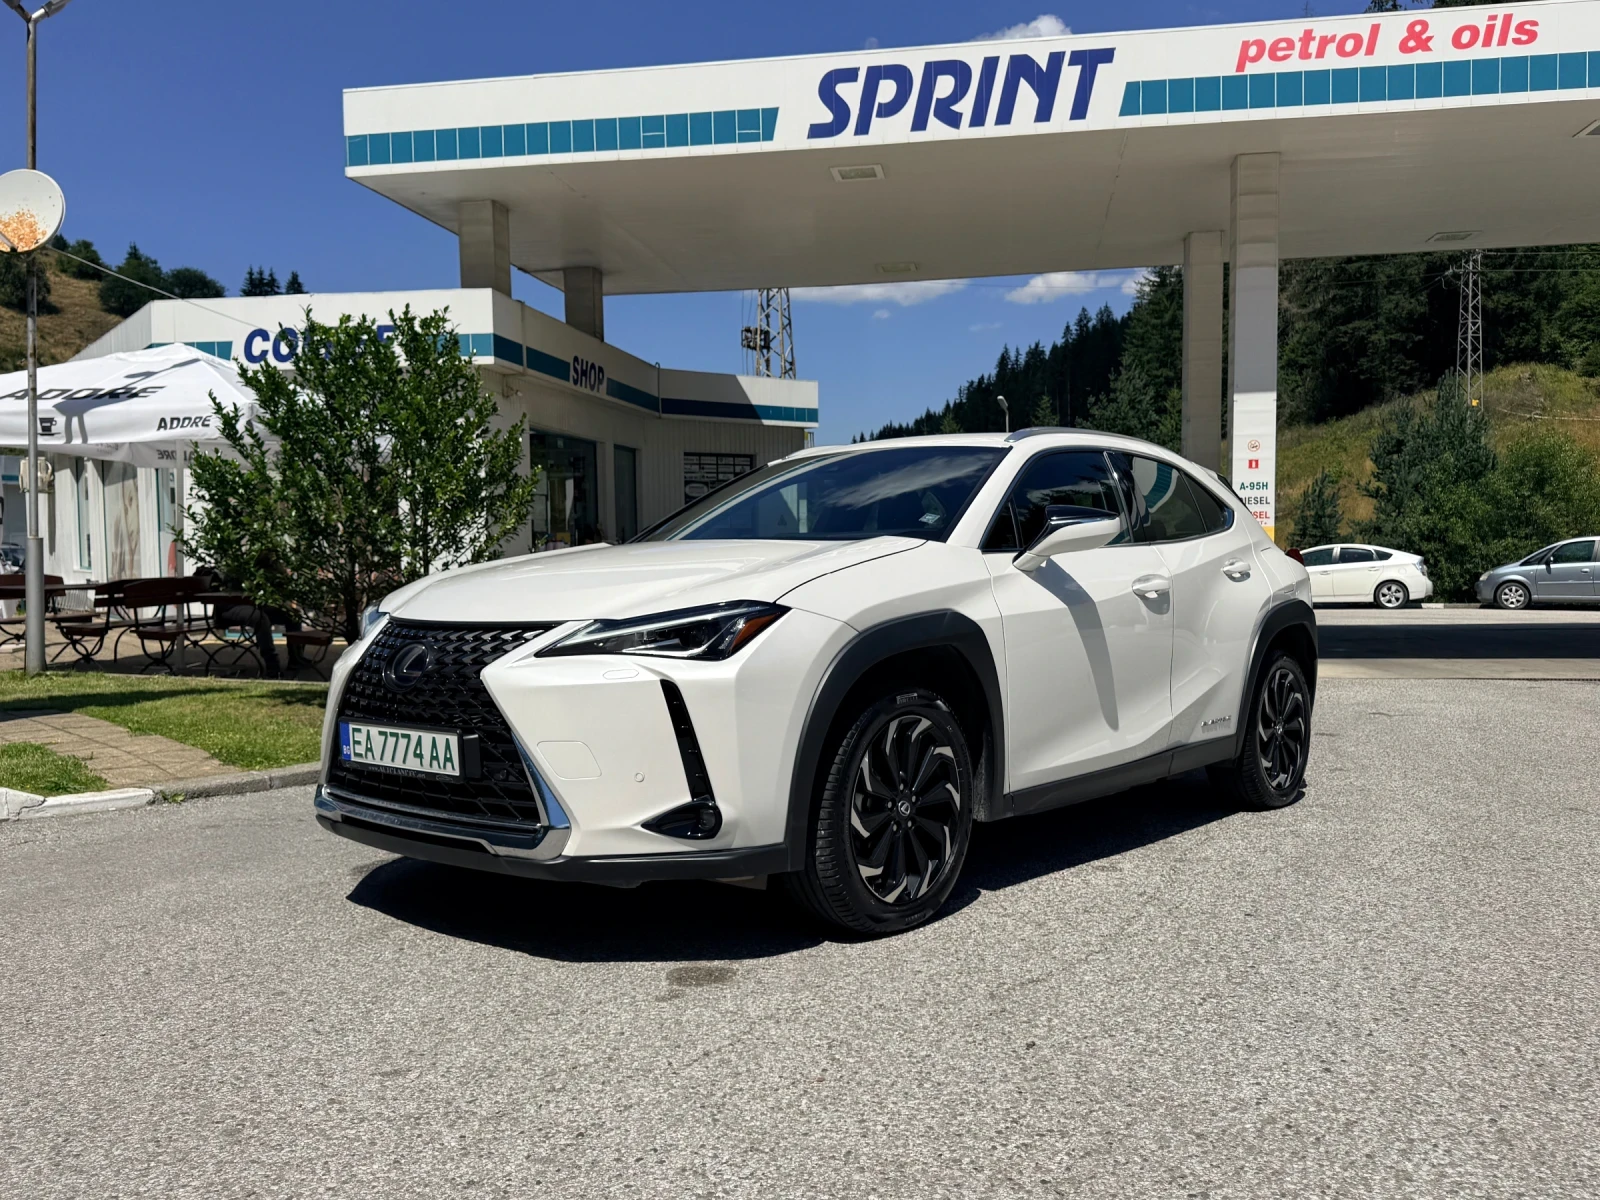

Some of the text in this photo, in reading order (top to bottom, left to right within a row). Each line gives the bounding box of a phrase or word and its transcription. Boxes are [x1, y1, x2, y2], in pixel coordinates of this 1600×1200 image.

[1235, 13, 1539, 72] petrol & oils
[807, 47, 1116, 139] SPRINT
[572, 355, 605, 393] SHOP
[1239, 481, 1269, 490] A-95H
[1252, 511, 1270, 519] SEL
